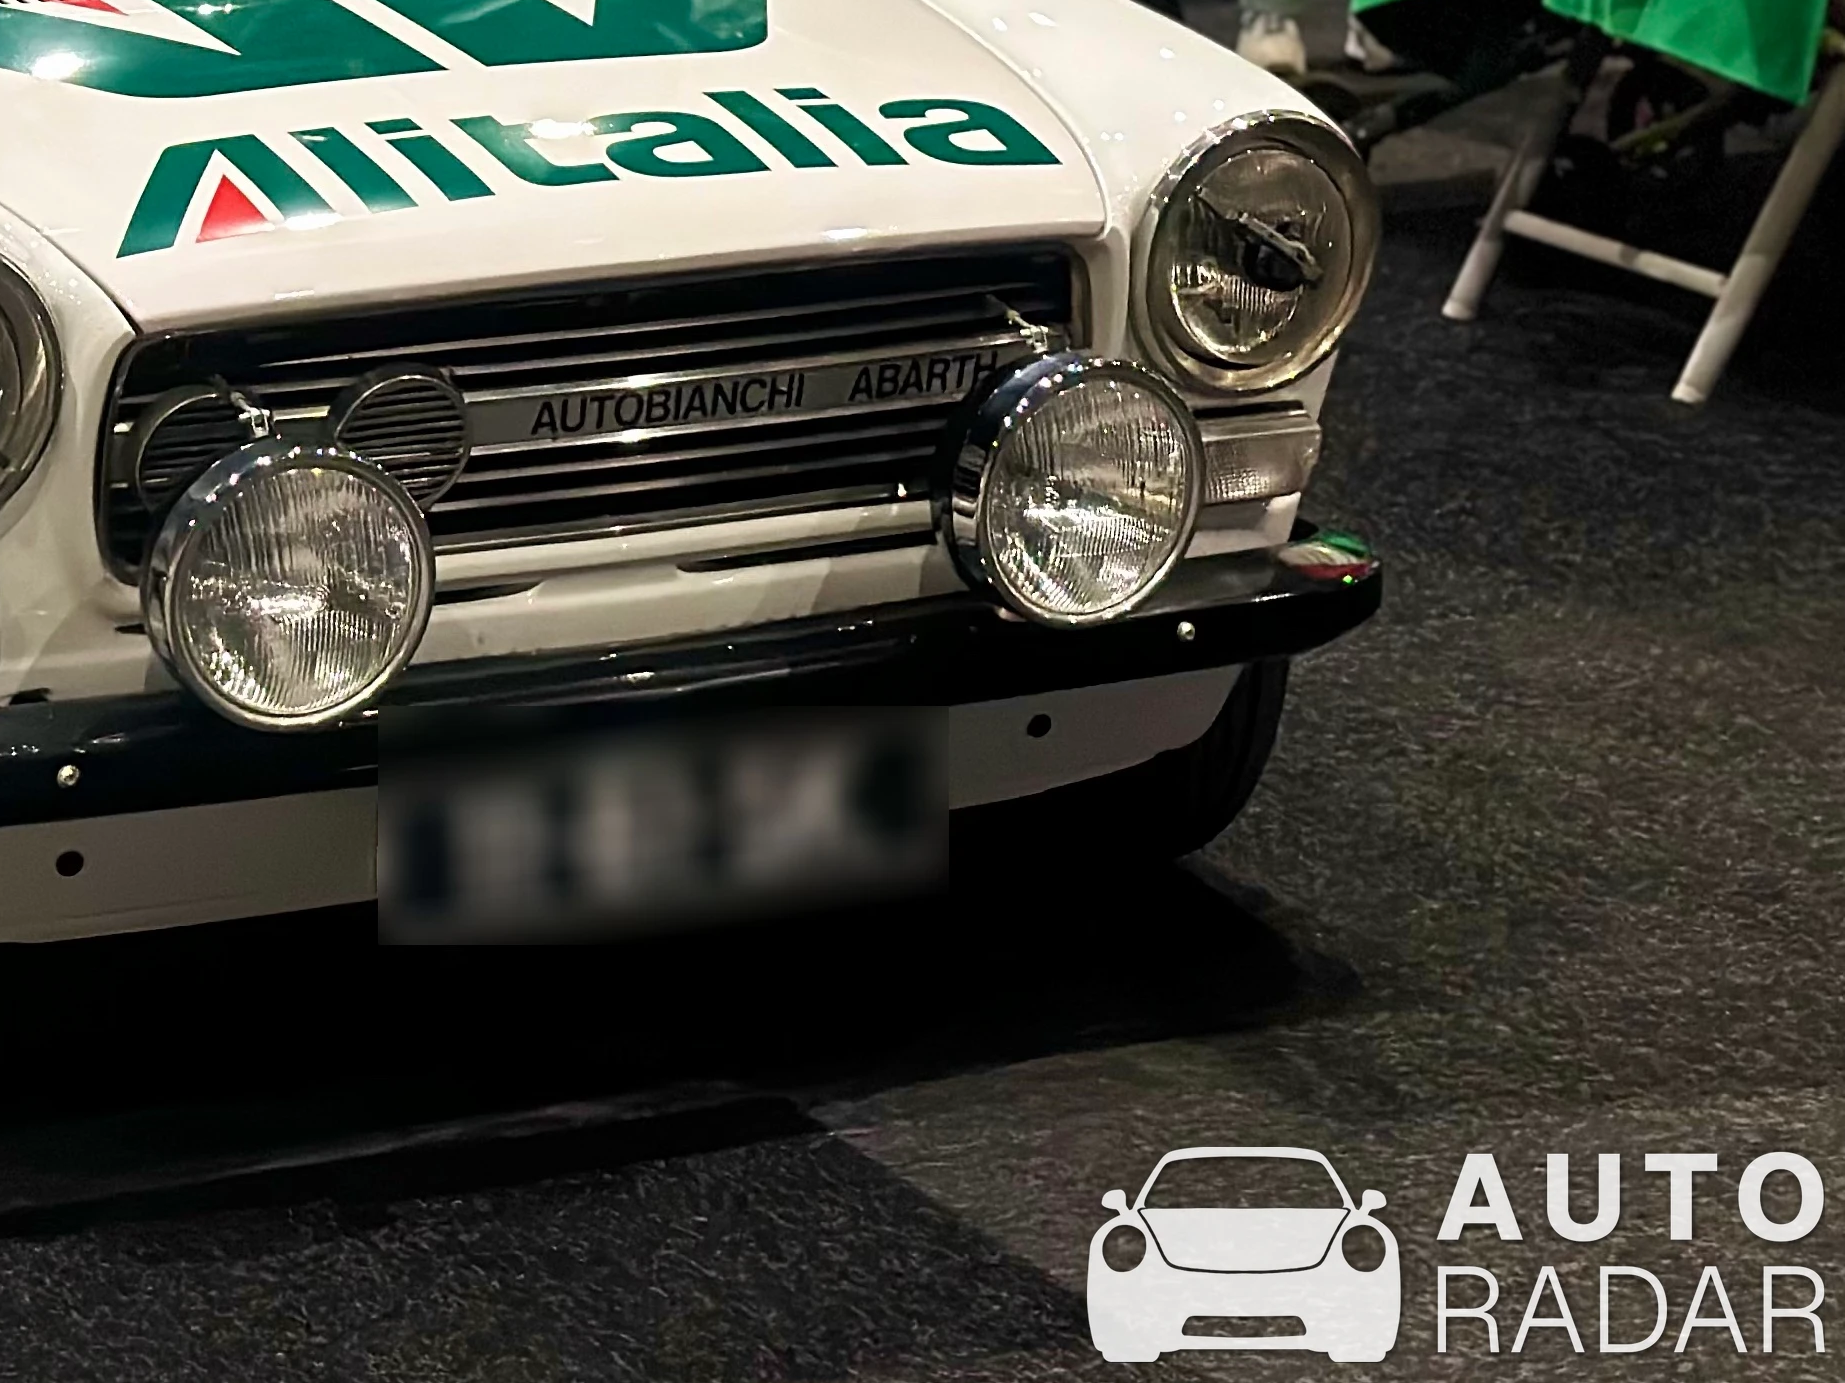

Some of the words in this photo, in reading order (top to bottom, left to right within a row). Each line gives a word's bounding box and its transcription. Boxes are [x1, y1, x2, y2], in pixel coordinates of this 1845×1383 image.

[115, 86, 1063, 260] Alitalia
[530, 372, 806, 436] AUTOBIANCHI
[848, 349, 999, 402] ABARTH
